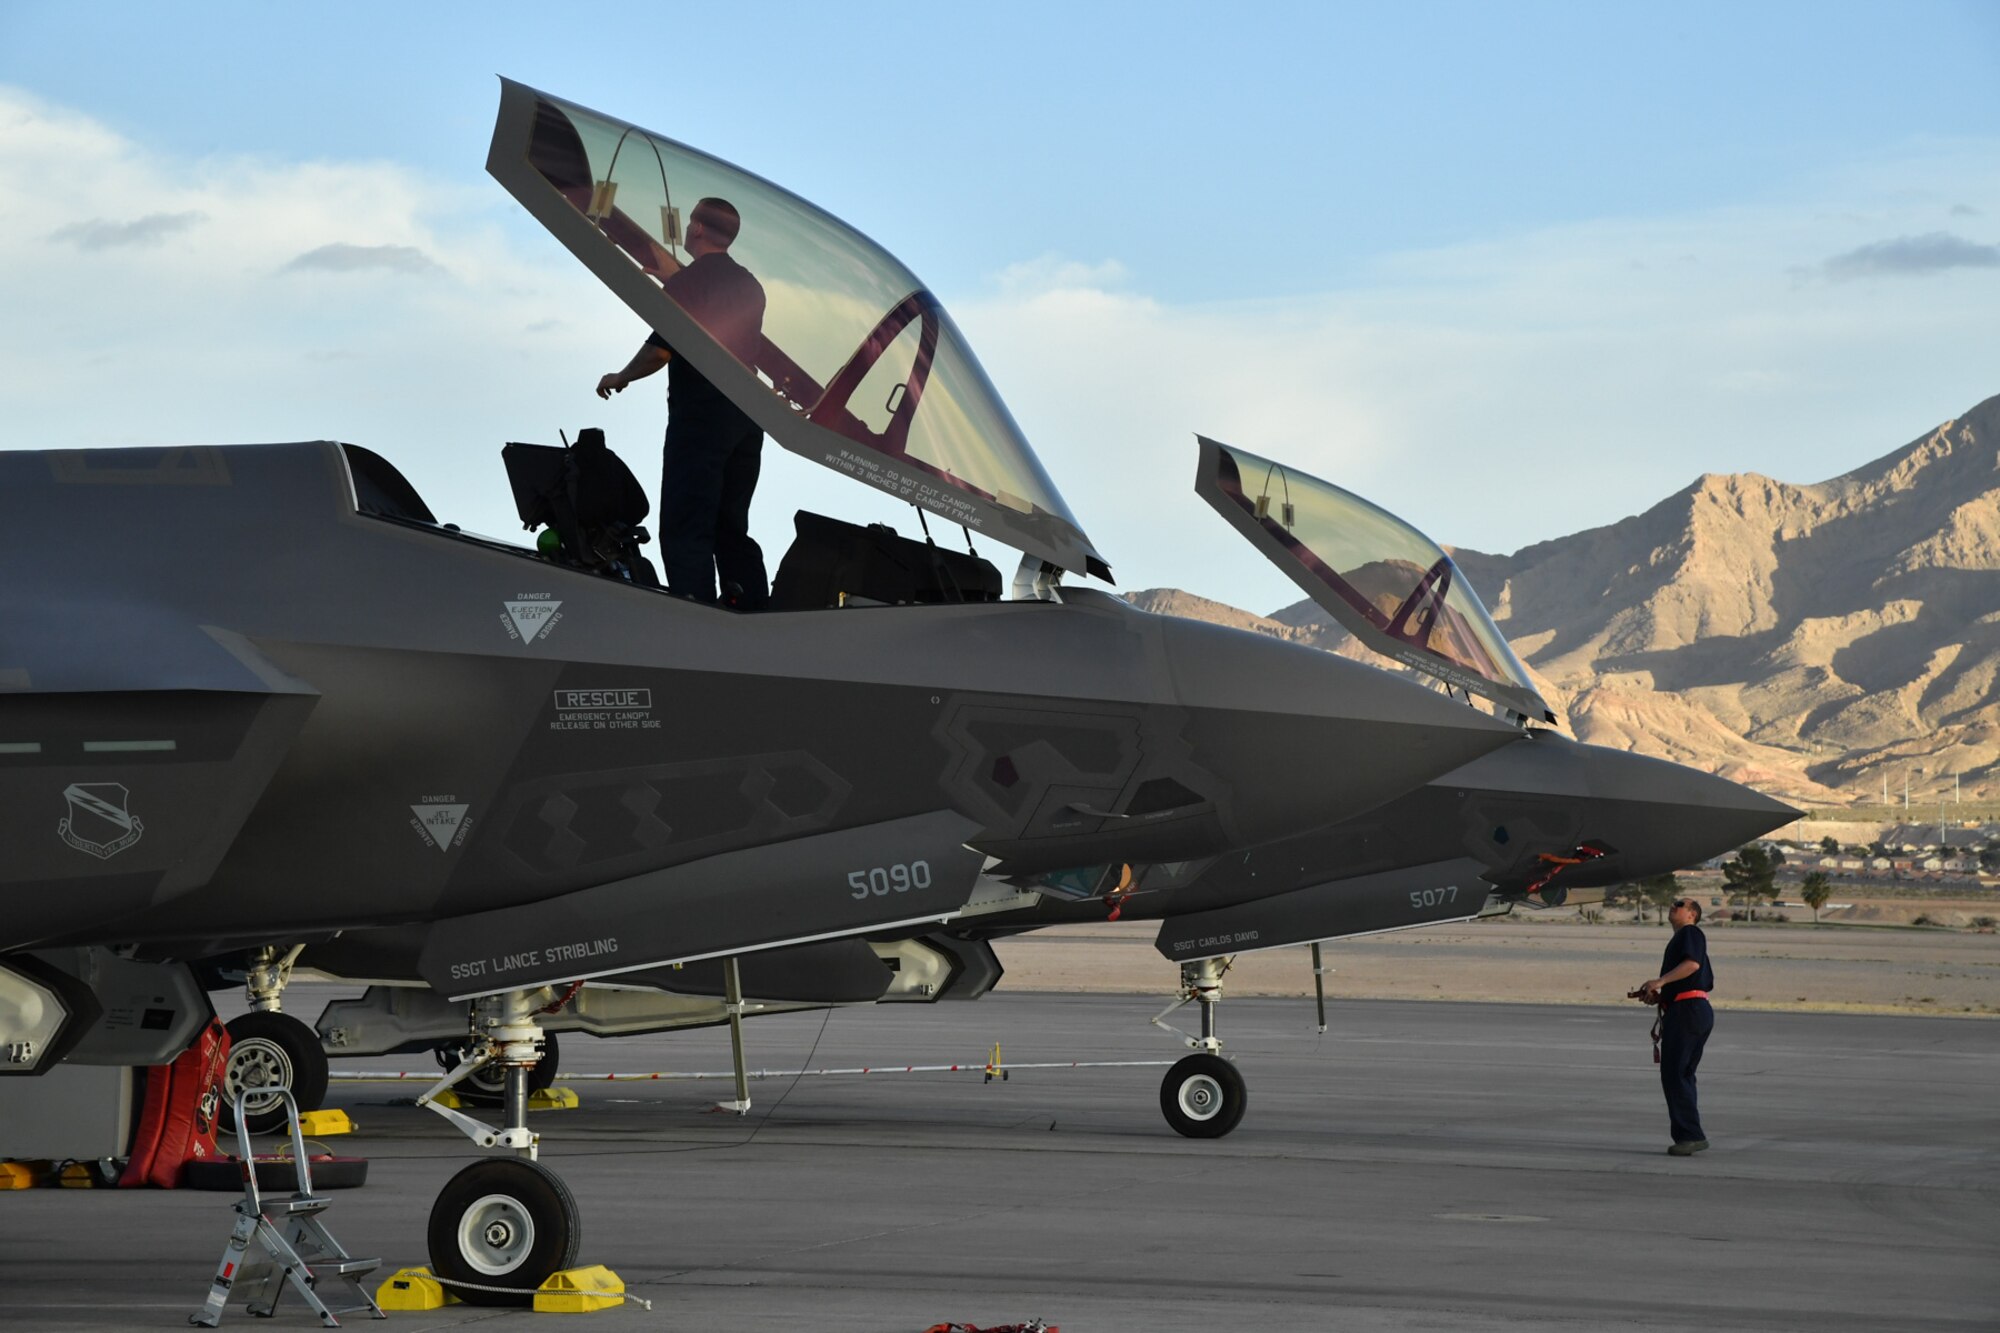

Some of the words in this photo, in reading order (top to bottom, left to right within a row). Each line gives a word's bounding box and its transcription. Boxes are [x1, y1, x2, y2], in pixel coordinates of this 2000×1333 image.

[825, 454, 856, 472] WITHIN
[866, 472, 898, 490] INCHES
[900, 486, 912, 495] OF
[915, 493, 950, 513] CANOPY
[952, 508, 983, 526] FRAME
[840, 449, 880, 472] WARNING
[886, 470, 898, 480] DO
[900, 476, 918, 488] NOT
[920, 484, 938, 497] CUT
[941, 494, 976, 514] CANOPY
[517, 592, 551, 600] DANGER
[499, 612, 519, 640] DANGER
[538, 612, 563, 640] DANGER
[566, 692, 639, 707] RESCUE
[550, 722, 590, 730] RELEASE
[593, 721, 606, 729] ON
[610, 720, 638, 728] OTHER
[641, 720, 662, 728] SIDE
[559, 712, 610, 720] EMERGENCY
[615, 712, 650, 720] CANOPY
[422, 794, 456, 803] DANGER
[433, 810, 449, 818] JET
[410, 818, 434, 847] DANGER
[453, 817, 473, 846] DANGER
[848, 860, 932, 900] 5090
[1410, 886, 1458, 908] 5077
[1173, 939, 1195, 951] SSGT
[1199, 934, 1232, 947] CARLOS
[1234, 930, 1259, 942] DAVID
[450, 960, 487, 979] SSGT
[492, 951, 540, 972] LANCE
[545, 937, 618, 963] STRIBLING
